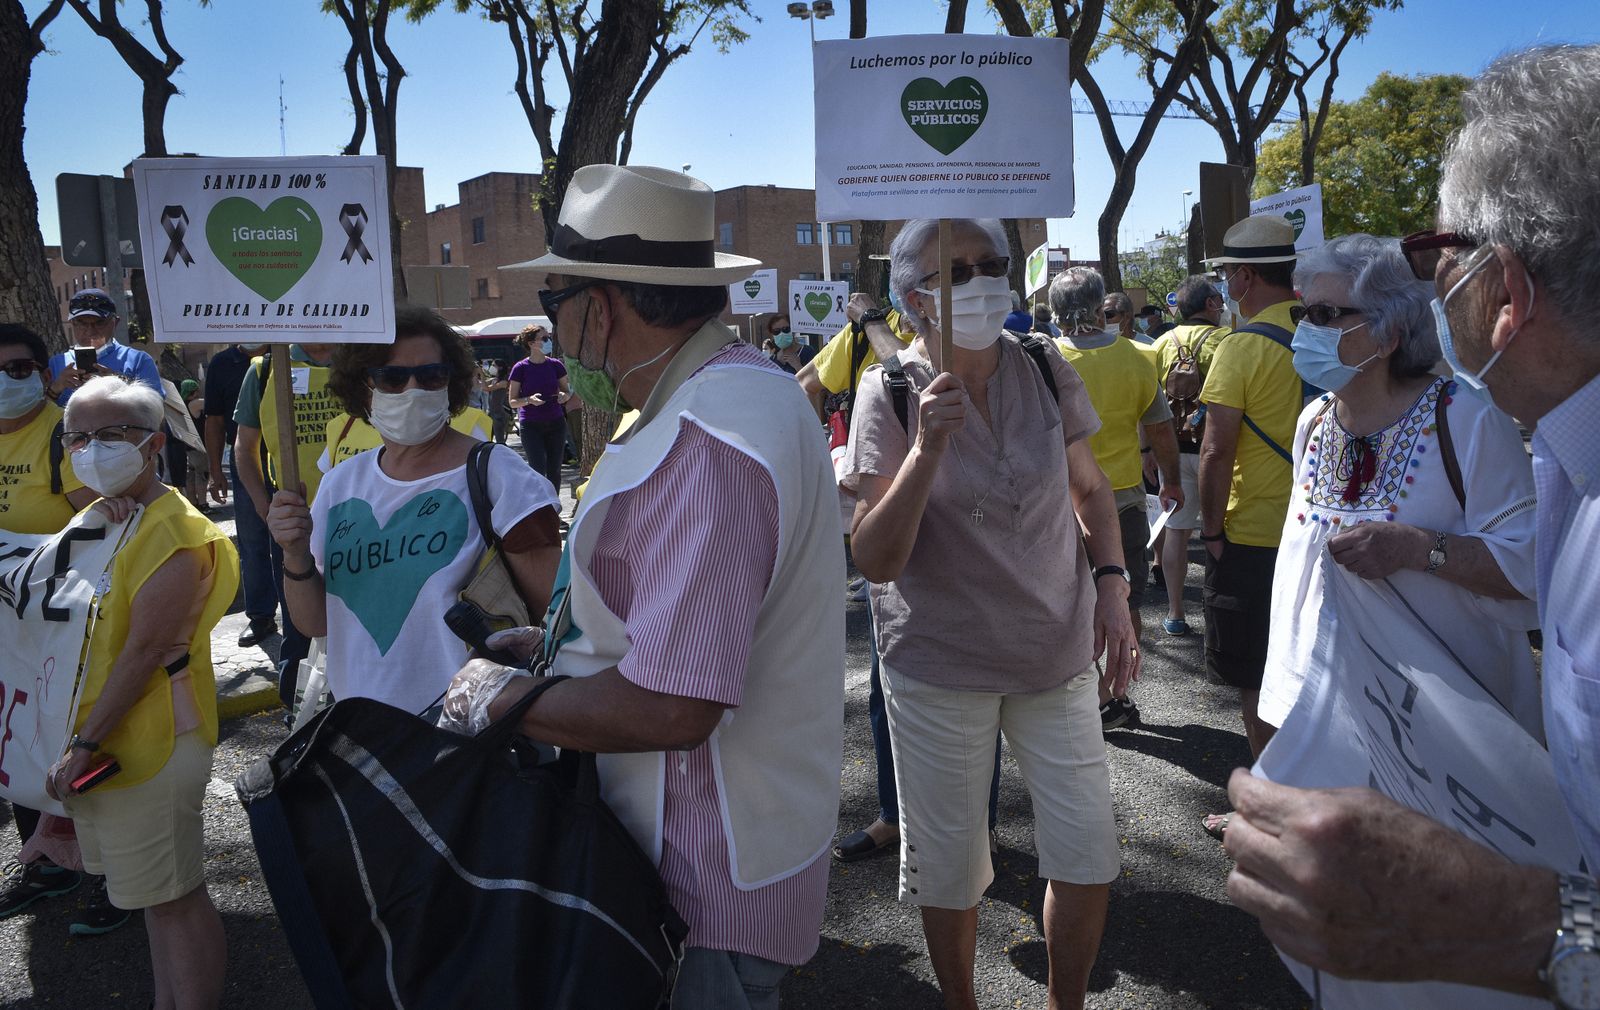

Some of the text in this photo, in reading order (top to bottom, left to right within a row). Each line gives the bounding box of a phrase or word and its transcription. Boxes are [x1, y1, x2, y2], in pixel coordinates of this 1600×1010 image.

[850, 51, 1033, 69] Luchemos por lo público
[907, 99, 982, 111] SERVICIOS
[910, 112, 979, 126] PÚBLICOS
[203, 173, 327, 190] SANIDAD 100 %
[837, 173, 1052, 185] GOBIERNE QUIEN GOBIERNE LO PUBLICO SE DEFIENDE
[851, 189, 888, 198] Plataforma
[929, 187, 956, 195] defensa
[977, 187, 1009, 195] pensiones
[1274, 201, 1285, 211] por
[1285, 199, 1291, 207] lo
[1291, 195, 1312, 206] público
[183, 303, 370, 317] PUBLICA Y DE CALIDAD
[329, 496, 440, 544] Por lo
[330, 531, 448, 581] PÚBLICO
